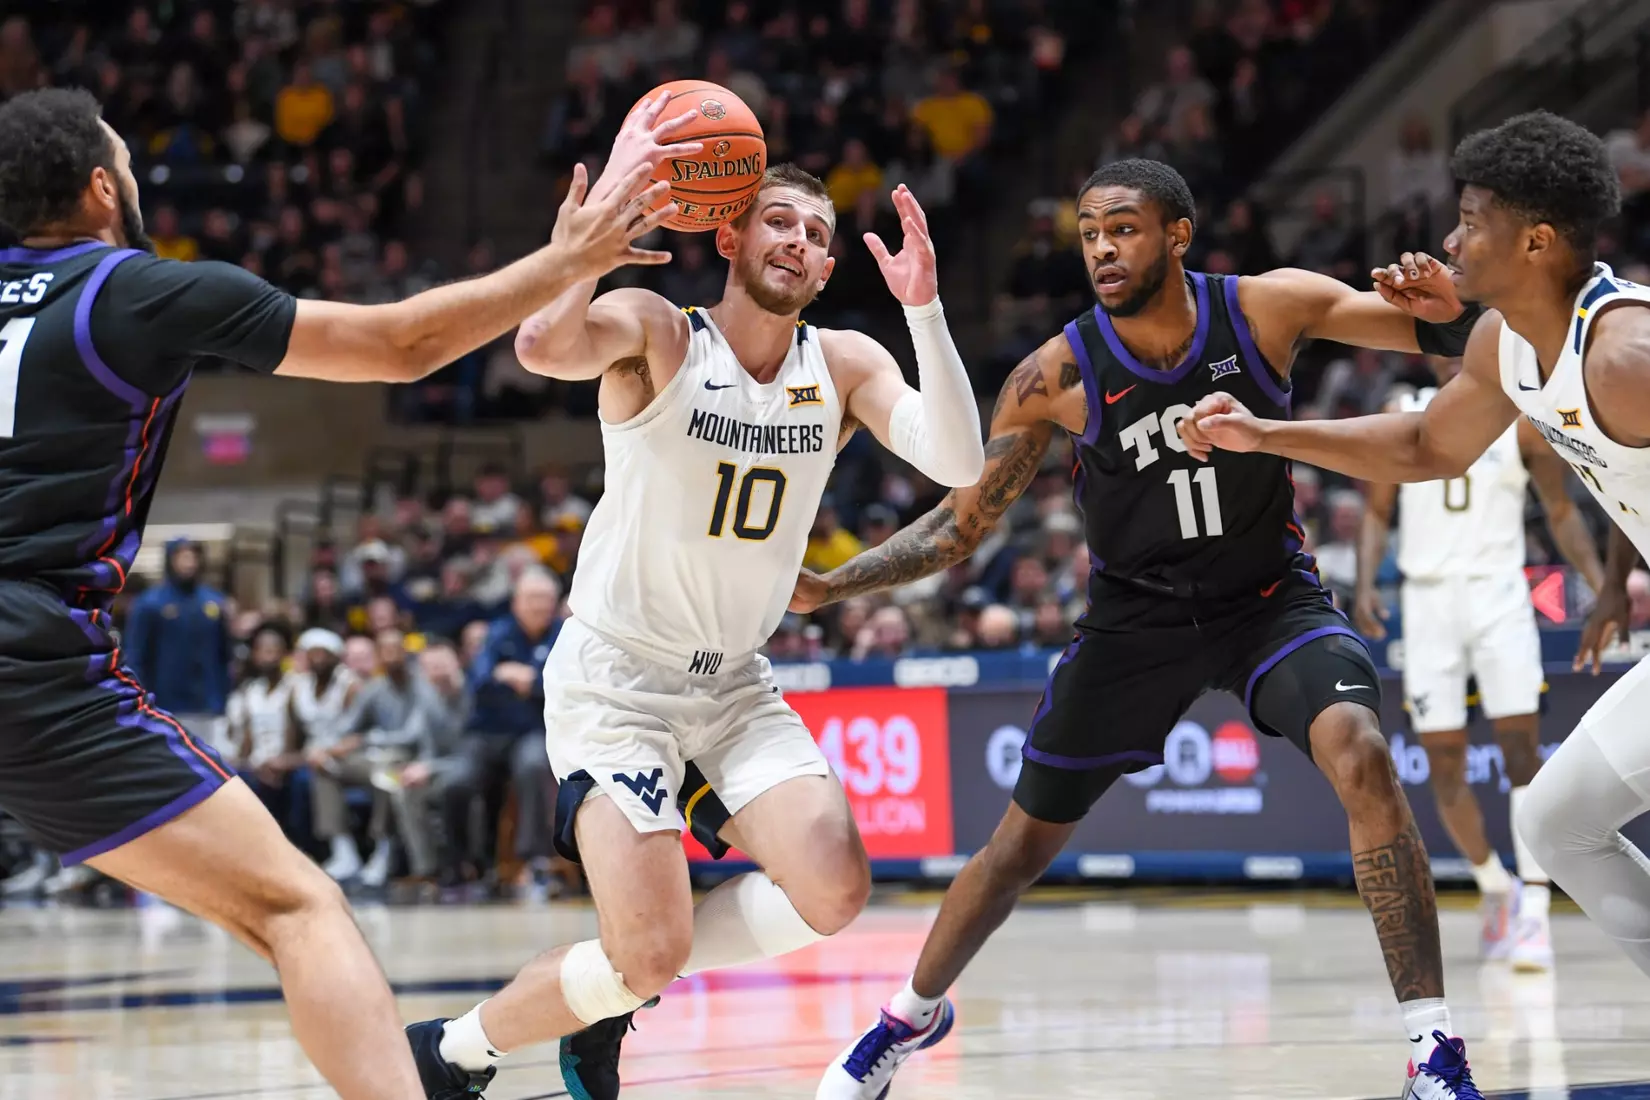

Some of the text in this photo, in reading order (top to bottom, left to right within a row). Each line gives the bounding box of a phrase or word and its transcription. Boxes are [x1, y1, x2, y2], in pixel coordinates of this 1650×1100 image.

[671, 152, 761, 182] SPALDING
[0, 272, 54, 304] ES
[1209, 355, 1240, 380] XII
[787, 384, 824, 407] XII
[687, 408, 823, 454] MOUNTAINEERS
[1557, 409, 1583, 428] XII
[1118, 402, 1200, 472] TC
[708, 460, 788, 541] 10
[1166, 466, 1223, 539] 11
[688, 650, 723, 675] WVU
